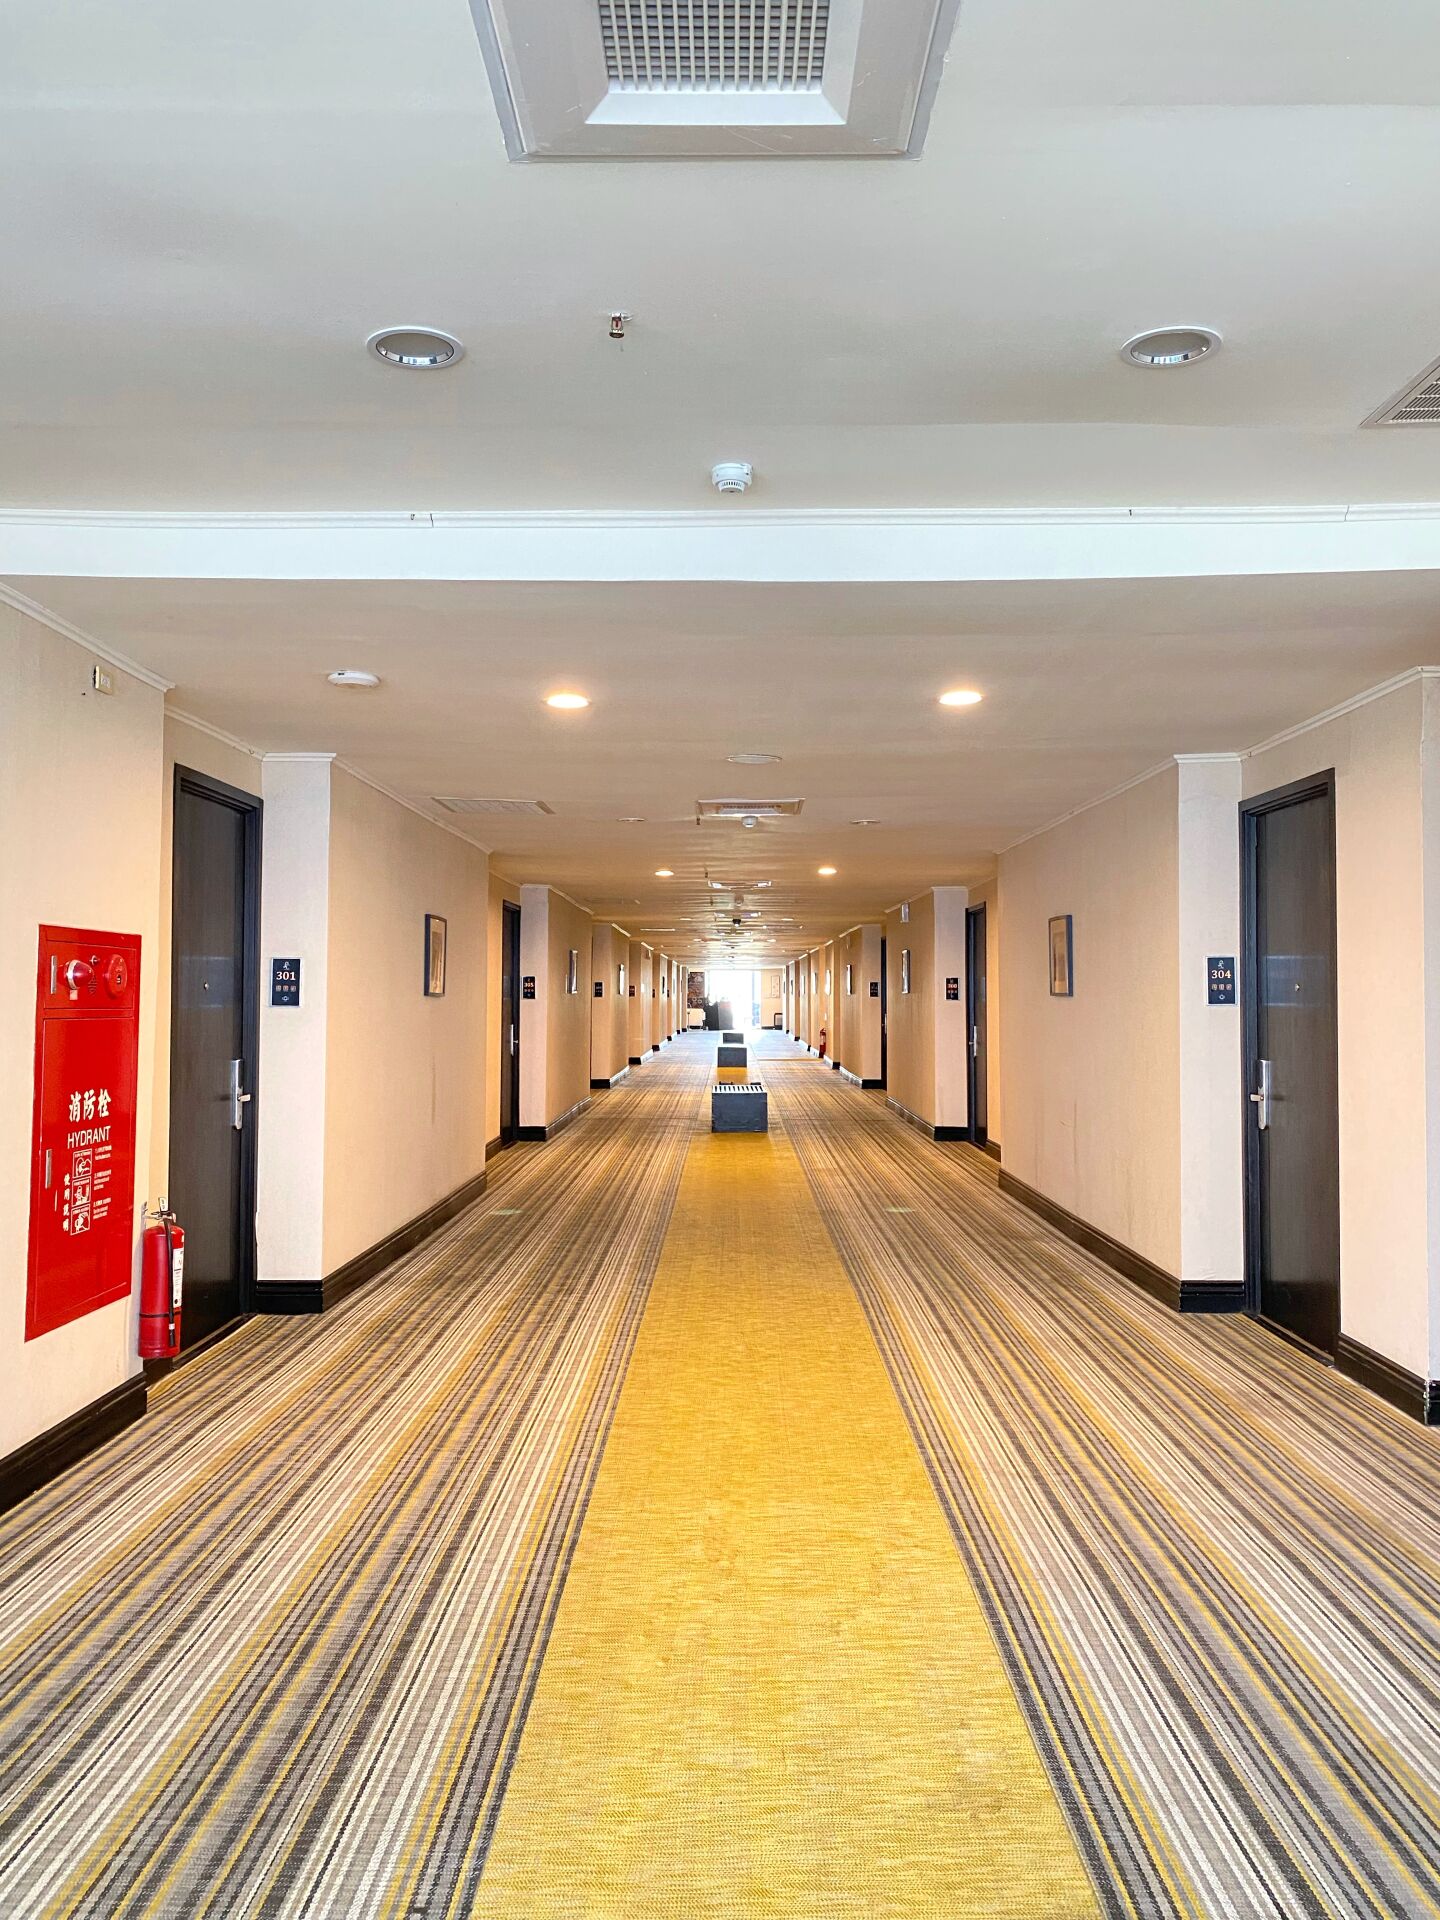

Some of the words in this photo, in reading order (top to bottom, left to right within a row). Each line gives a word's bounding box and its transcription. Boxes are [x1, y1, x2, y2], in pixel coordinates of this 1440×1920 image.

[276, 971, 296, 981] 301
[1211, 969, 1232, 979] 304
[69, 1088, 112, 1123] 消防栓
[67, 1126, 111, 1149] HYDRANT
